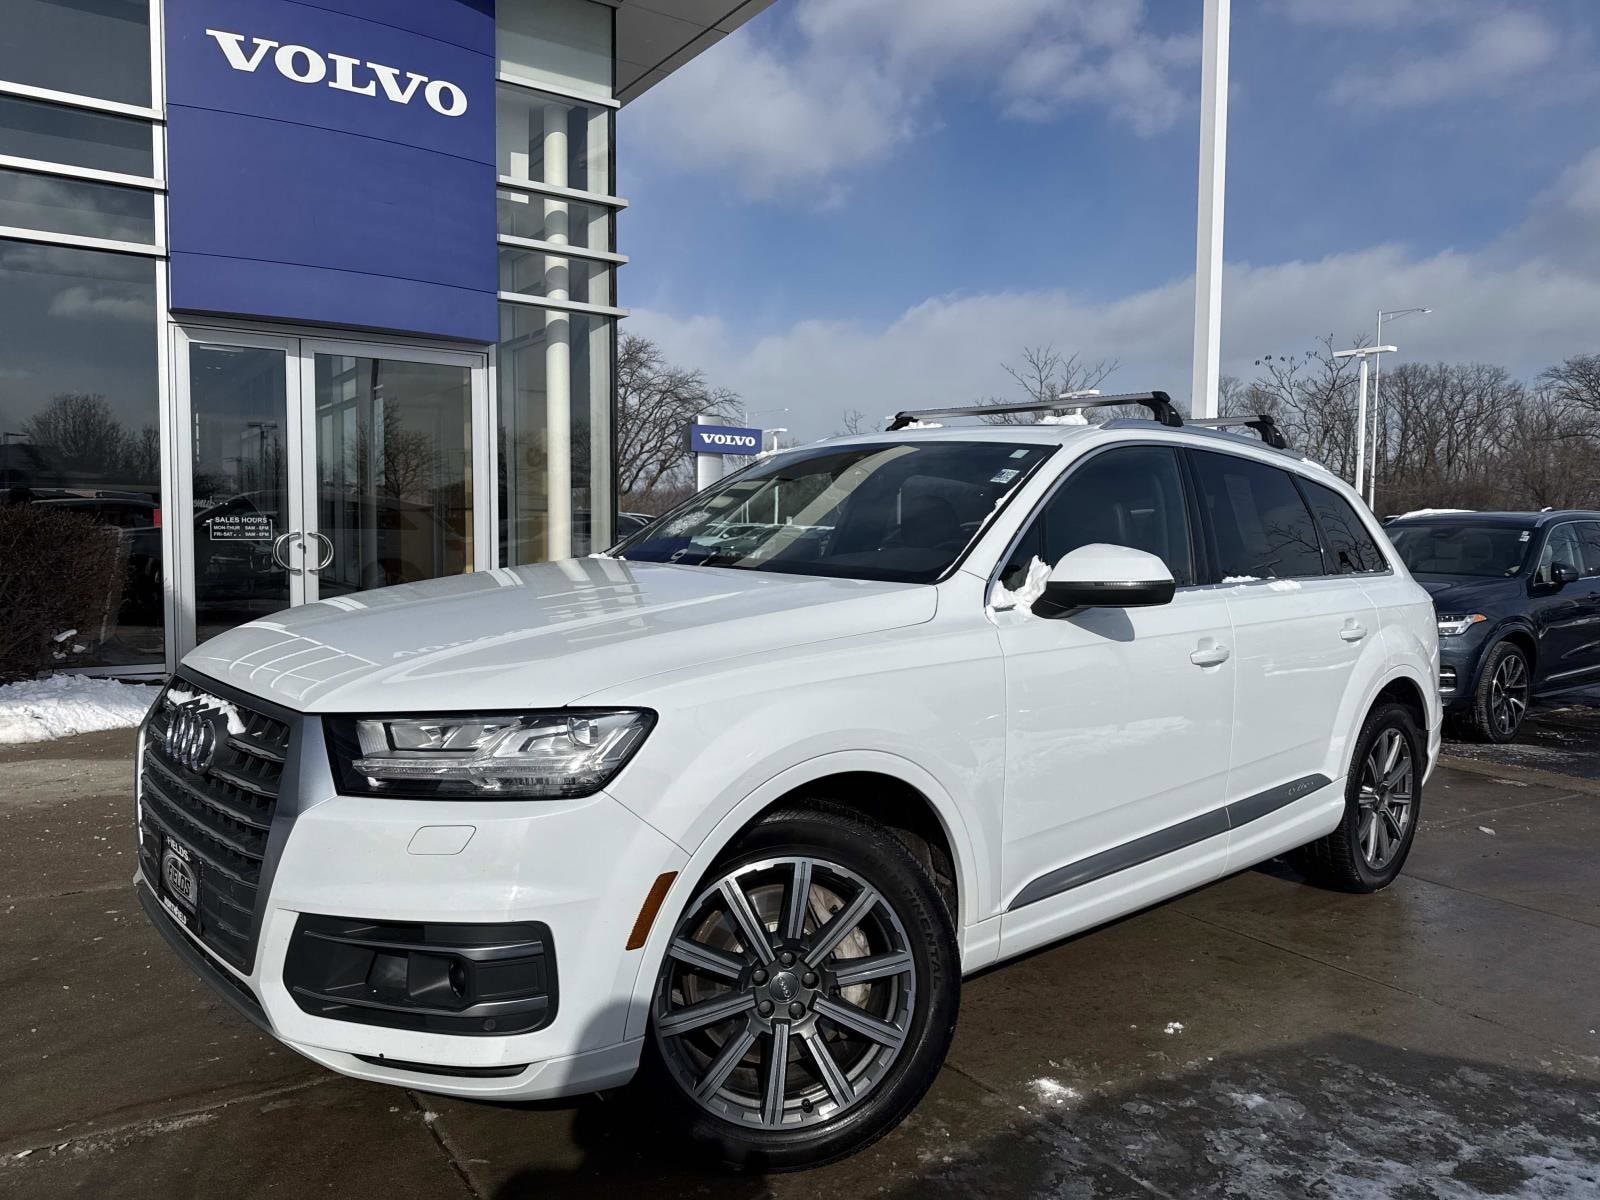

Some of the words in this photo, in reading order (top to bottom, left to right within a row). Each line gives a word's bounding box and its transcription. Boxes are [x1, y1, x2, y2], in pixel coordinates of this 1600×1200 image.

[206, 28, 468, 117] VOLVO
[700, 433, 756, 447] VOLVO
[166, 835, 190, 861] FIELDS
[168, 864, 191, 897] FIELDS
